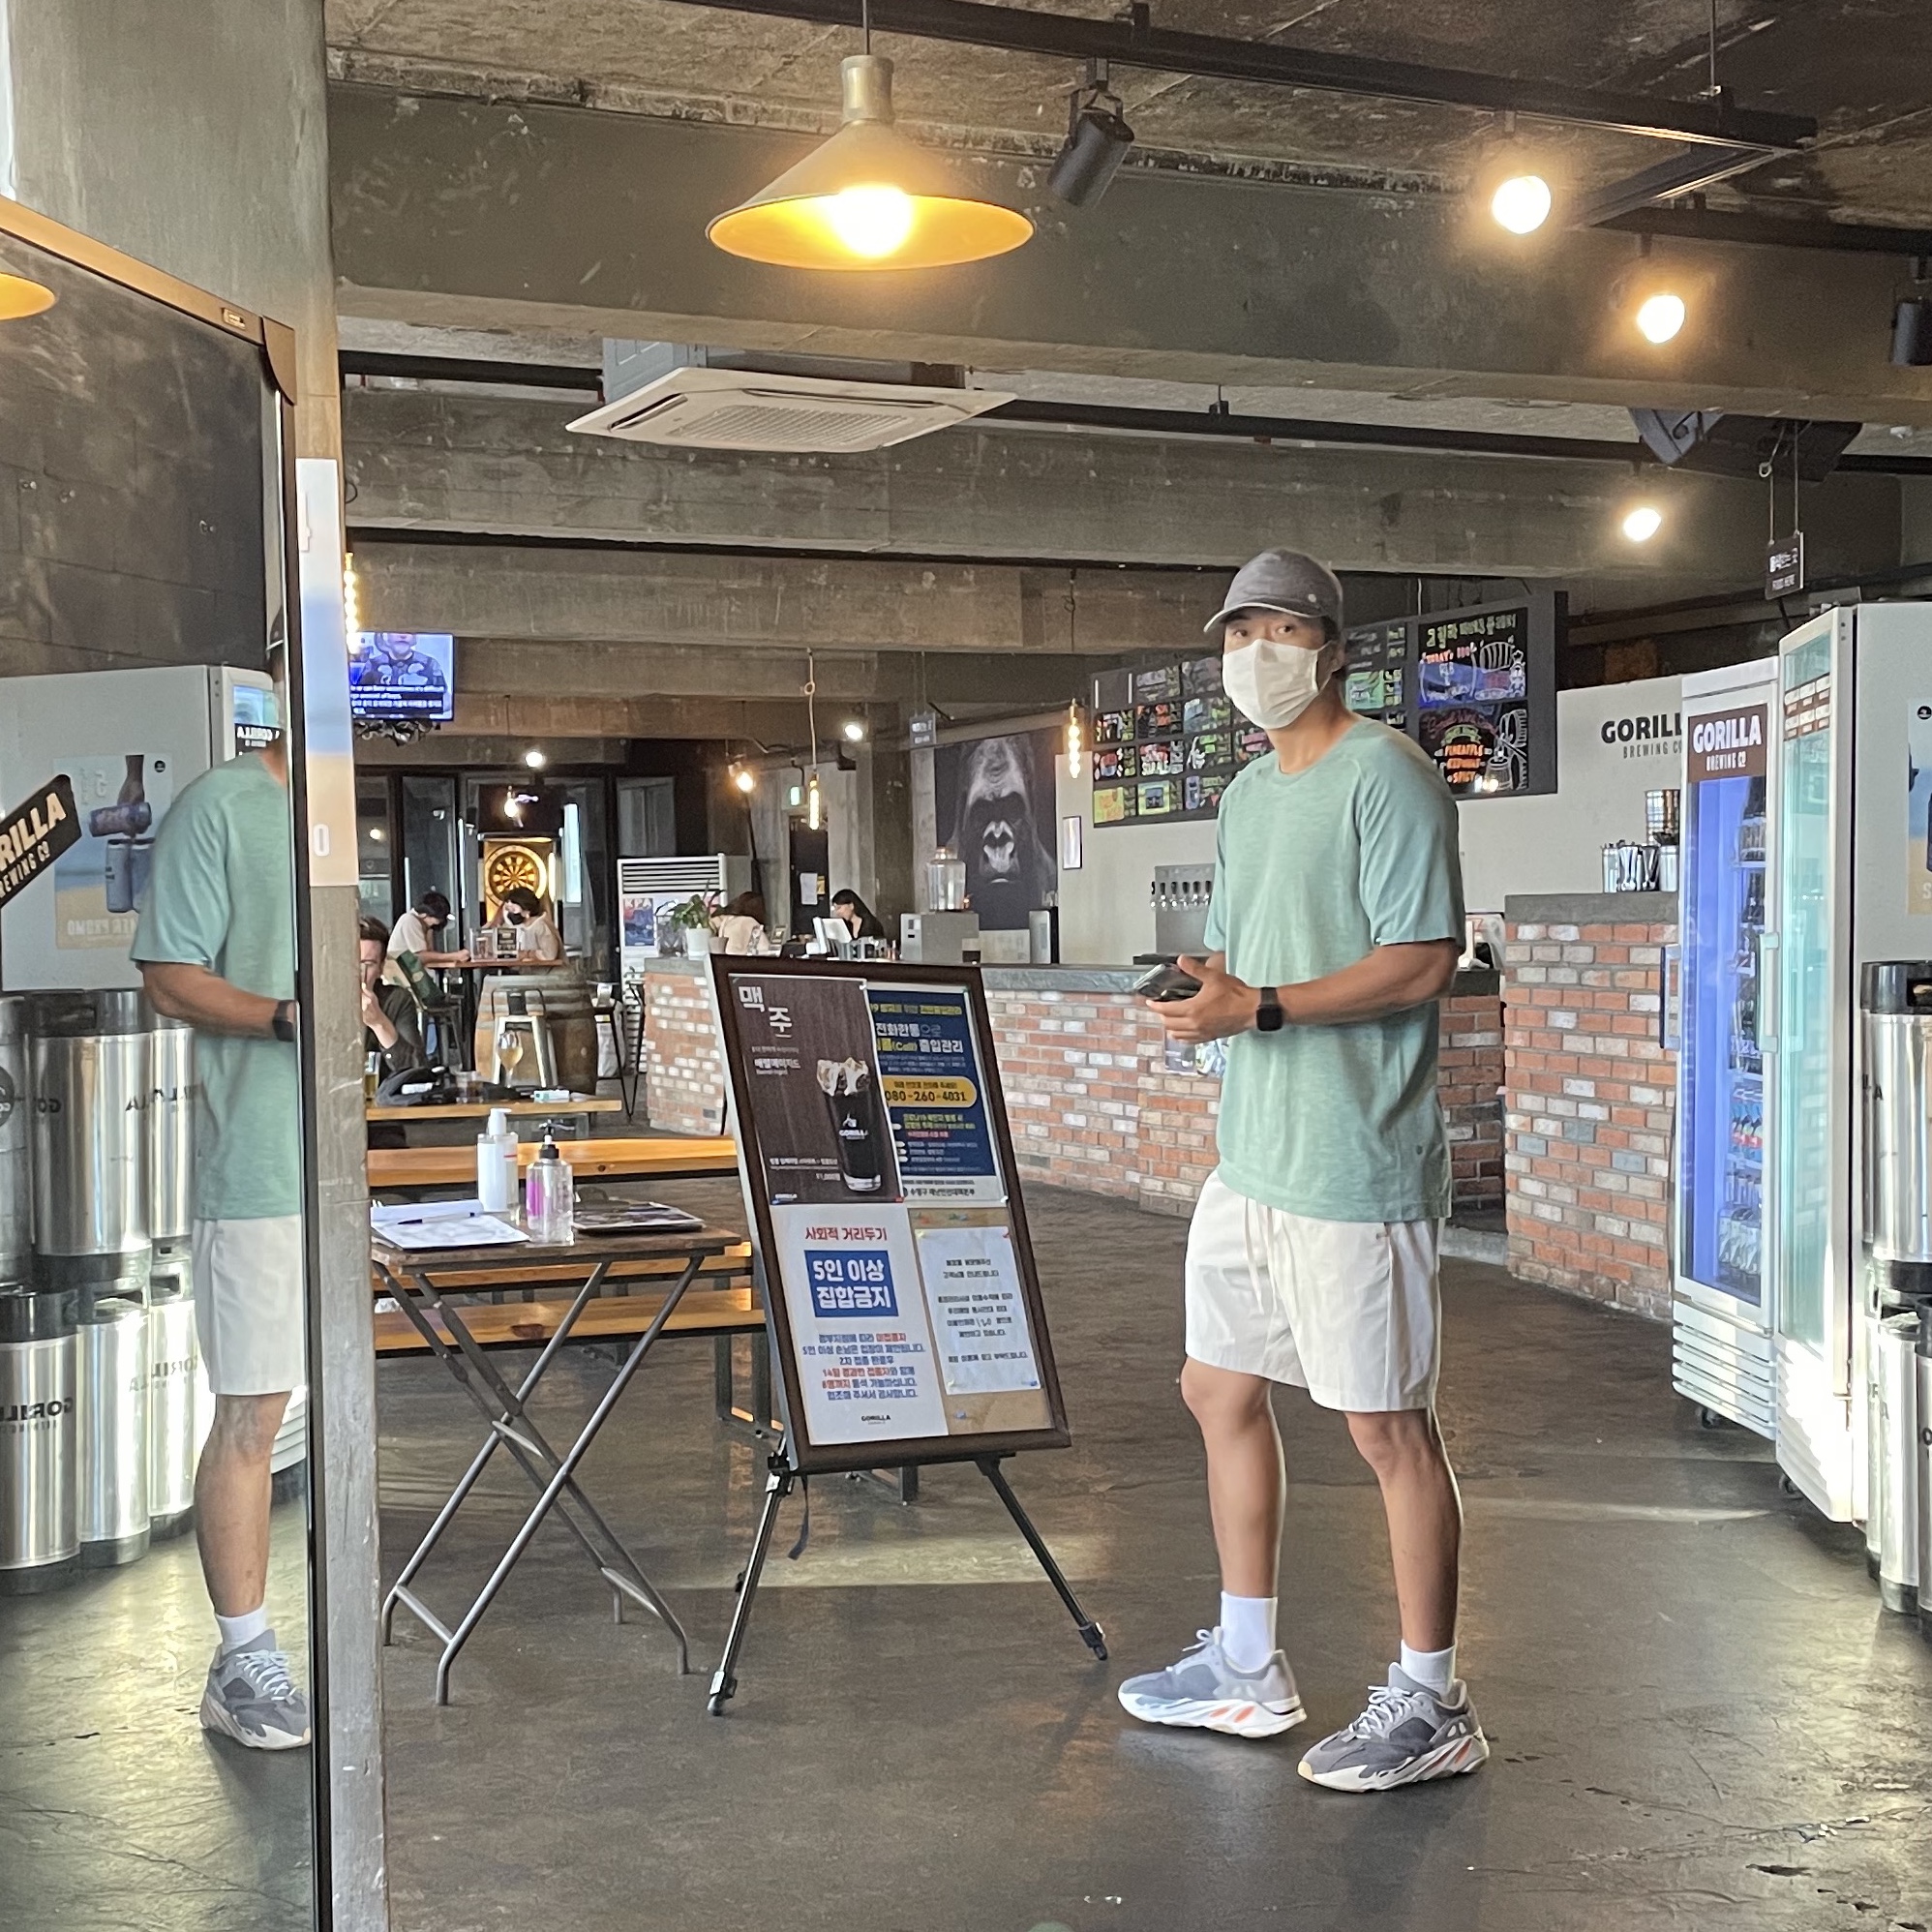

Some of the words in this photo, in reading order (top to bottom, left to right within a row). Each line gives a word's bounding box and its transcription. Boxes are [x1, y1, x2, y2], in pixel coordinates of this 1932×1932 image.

[1693, 714, 1762, 754] GORILLA
[1623, 742, 1668, 759] BREWING
[885, 1090, 967, 1102] 080-260-4031
[805, 1226, 839, 1241] 사회적
[841, 1226, 888, 1241] 거리두기
[813, 1259, 844, 1282] 5인
[847, 1259, 885, 1282] 이상
[816, 1285, 891, 1309] 집합금지
